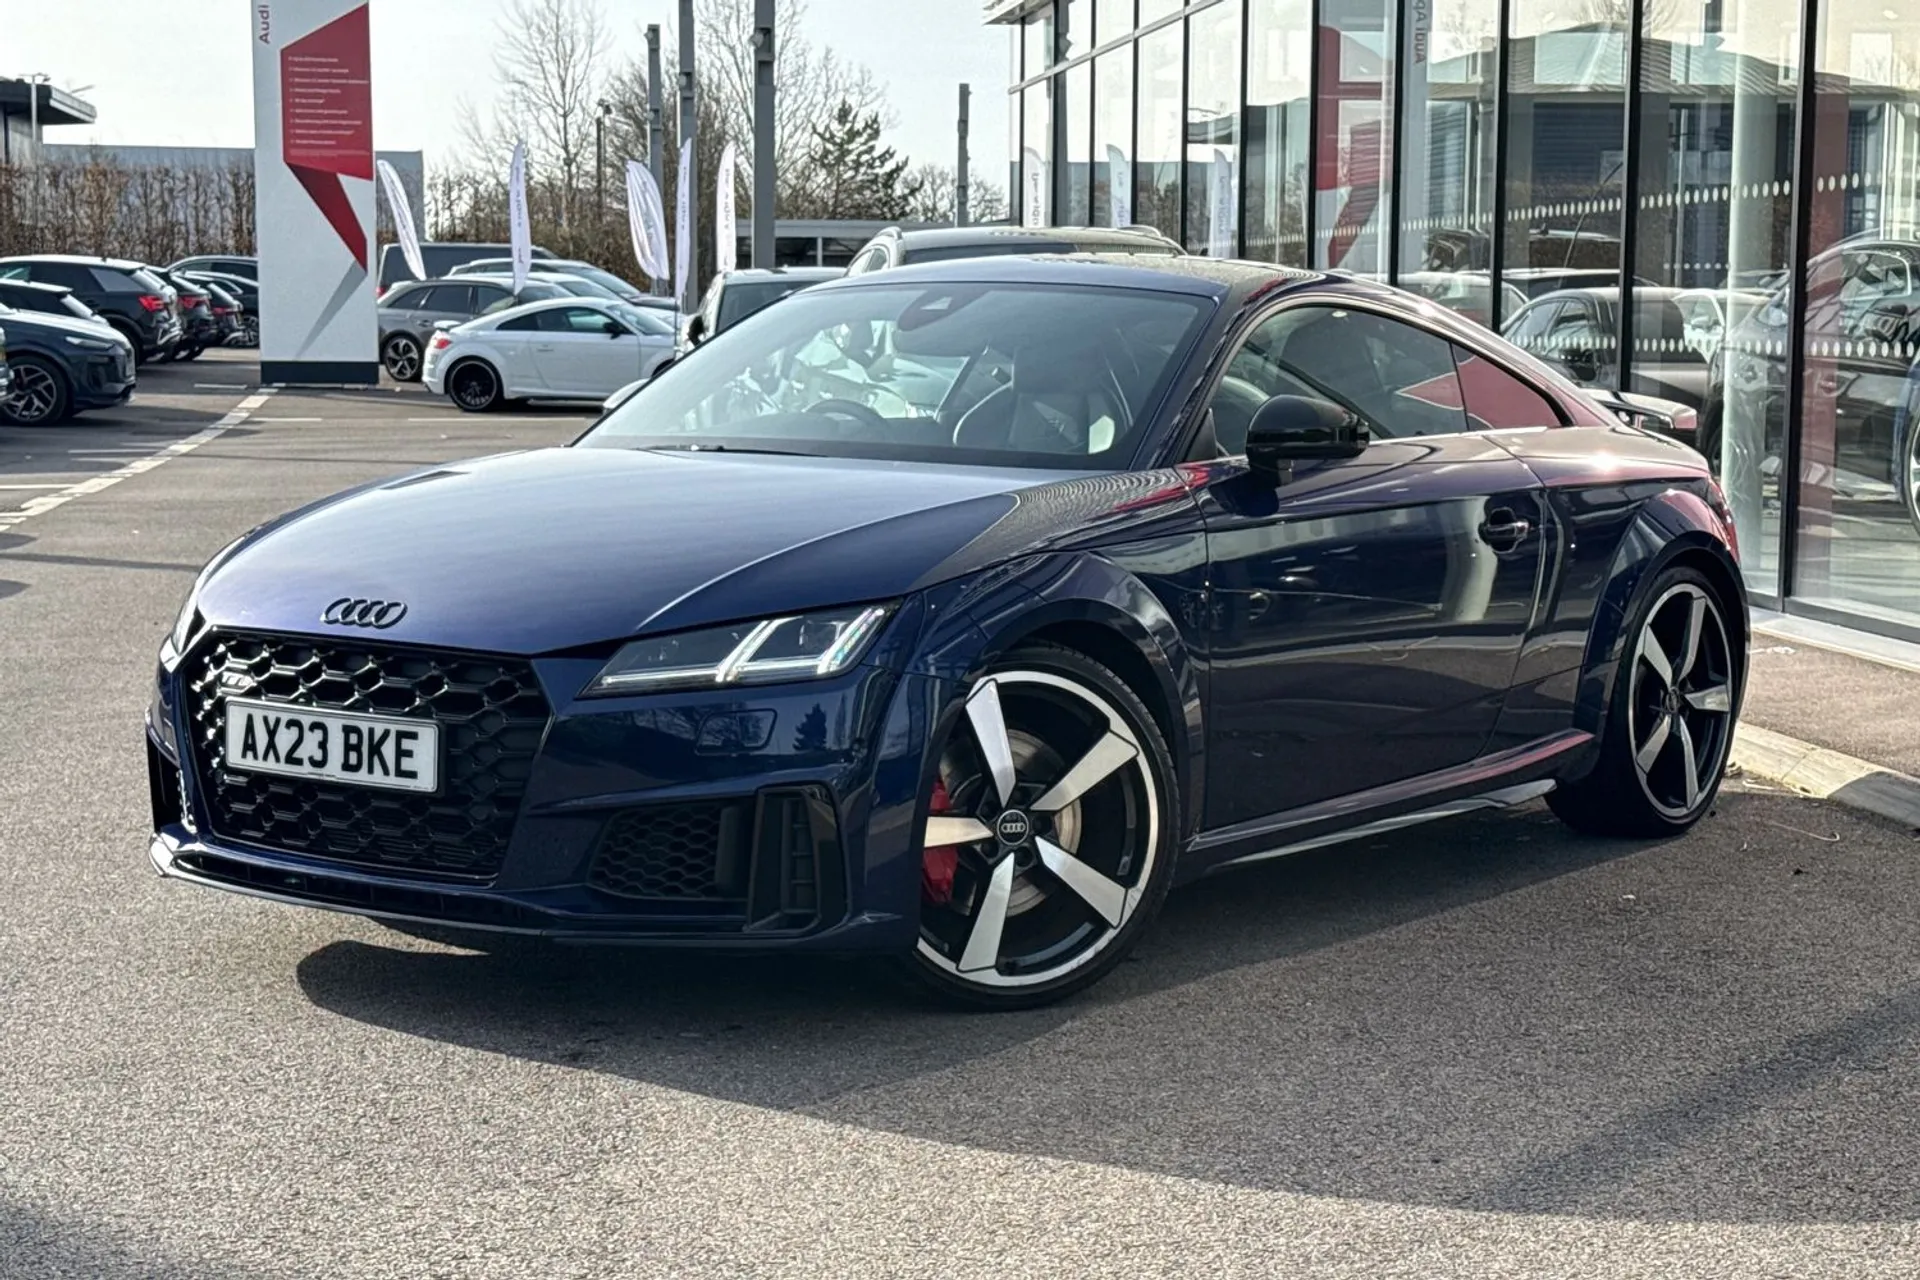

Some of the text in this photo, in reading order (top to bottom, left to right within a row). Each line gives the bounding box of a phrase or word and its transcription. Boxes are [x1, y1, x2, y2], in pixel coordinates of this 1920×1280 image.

[258, 4, 270, 45] Audi
[241, 713, 419, 780] AX23 BKE
